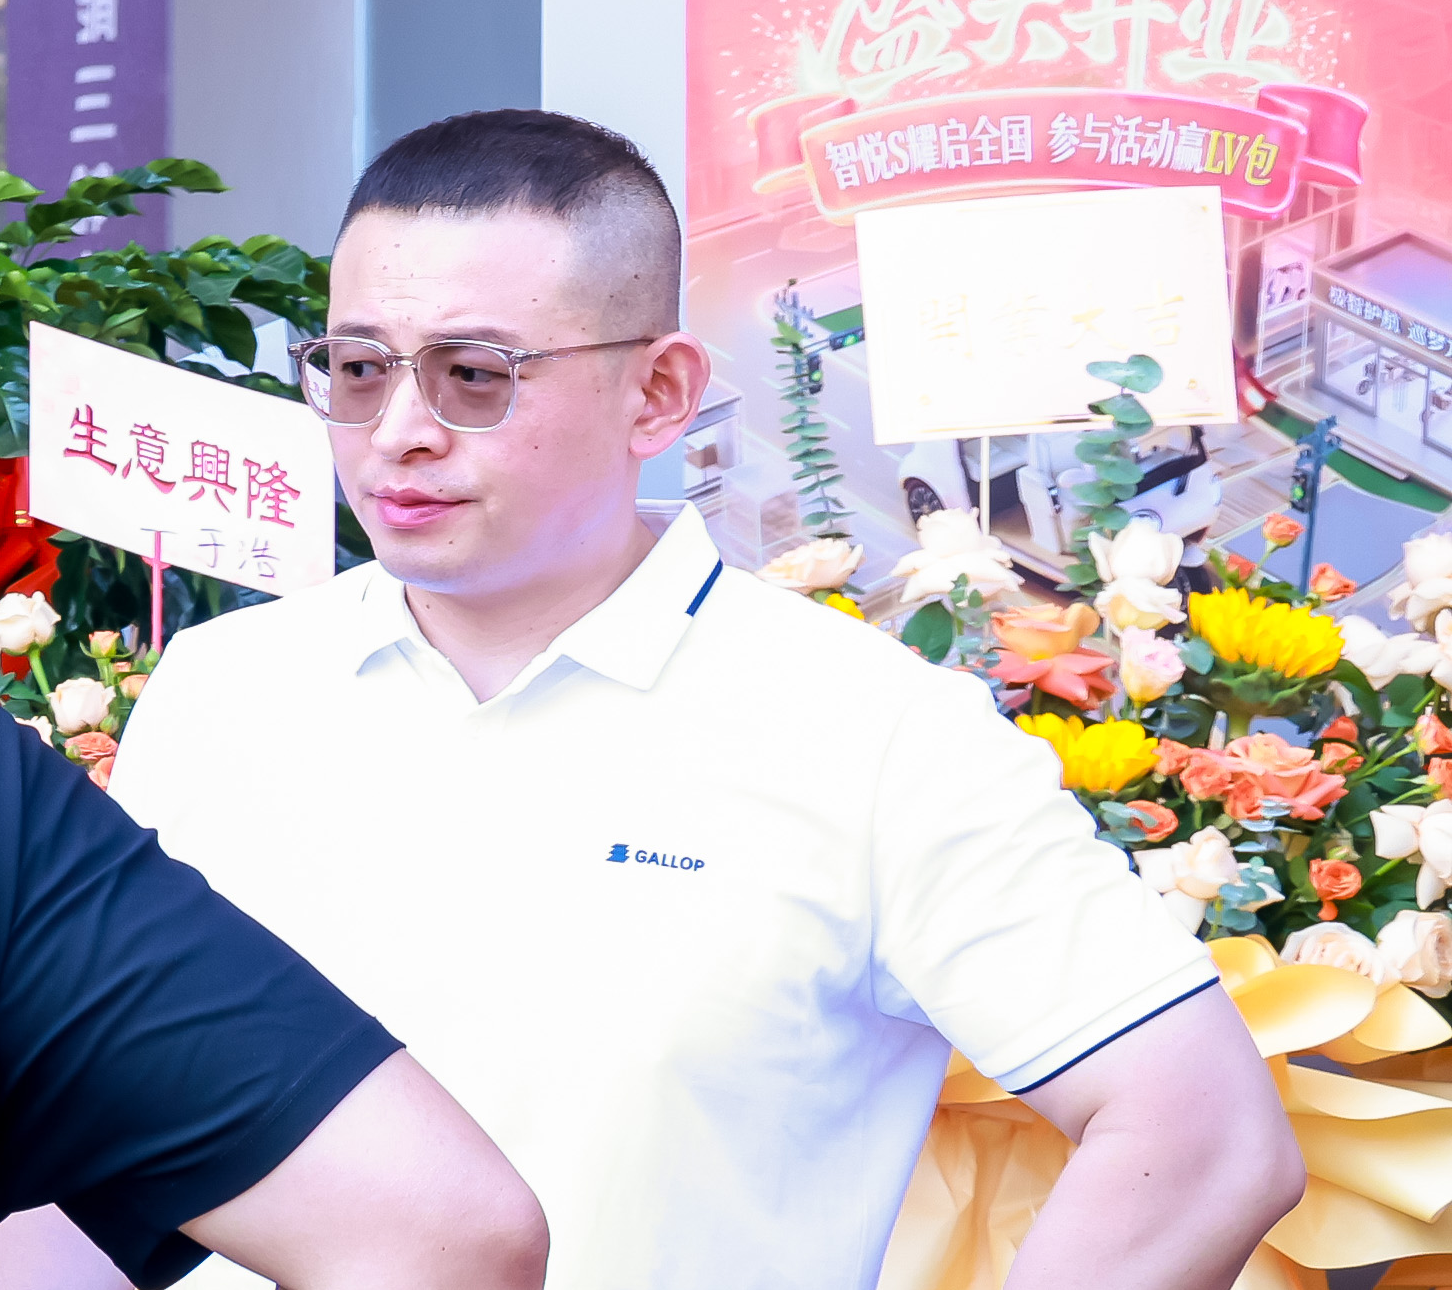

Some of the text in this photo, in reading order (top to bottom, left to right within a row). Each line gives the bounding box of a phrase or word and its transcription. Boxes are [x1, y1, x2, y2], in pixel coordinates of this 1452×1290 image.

[63, 404, 302, 529] 生意興隆
[634, 849, 706, 872] GALLOP
